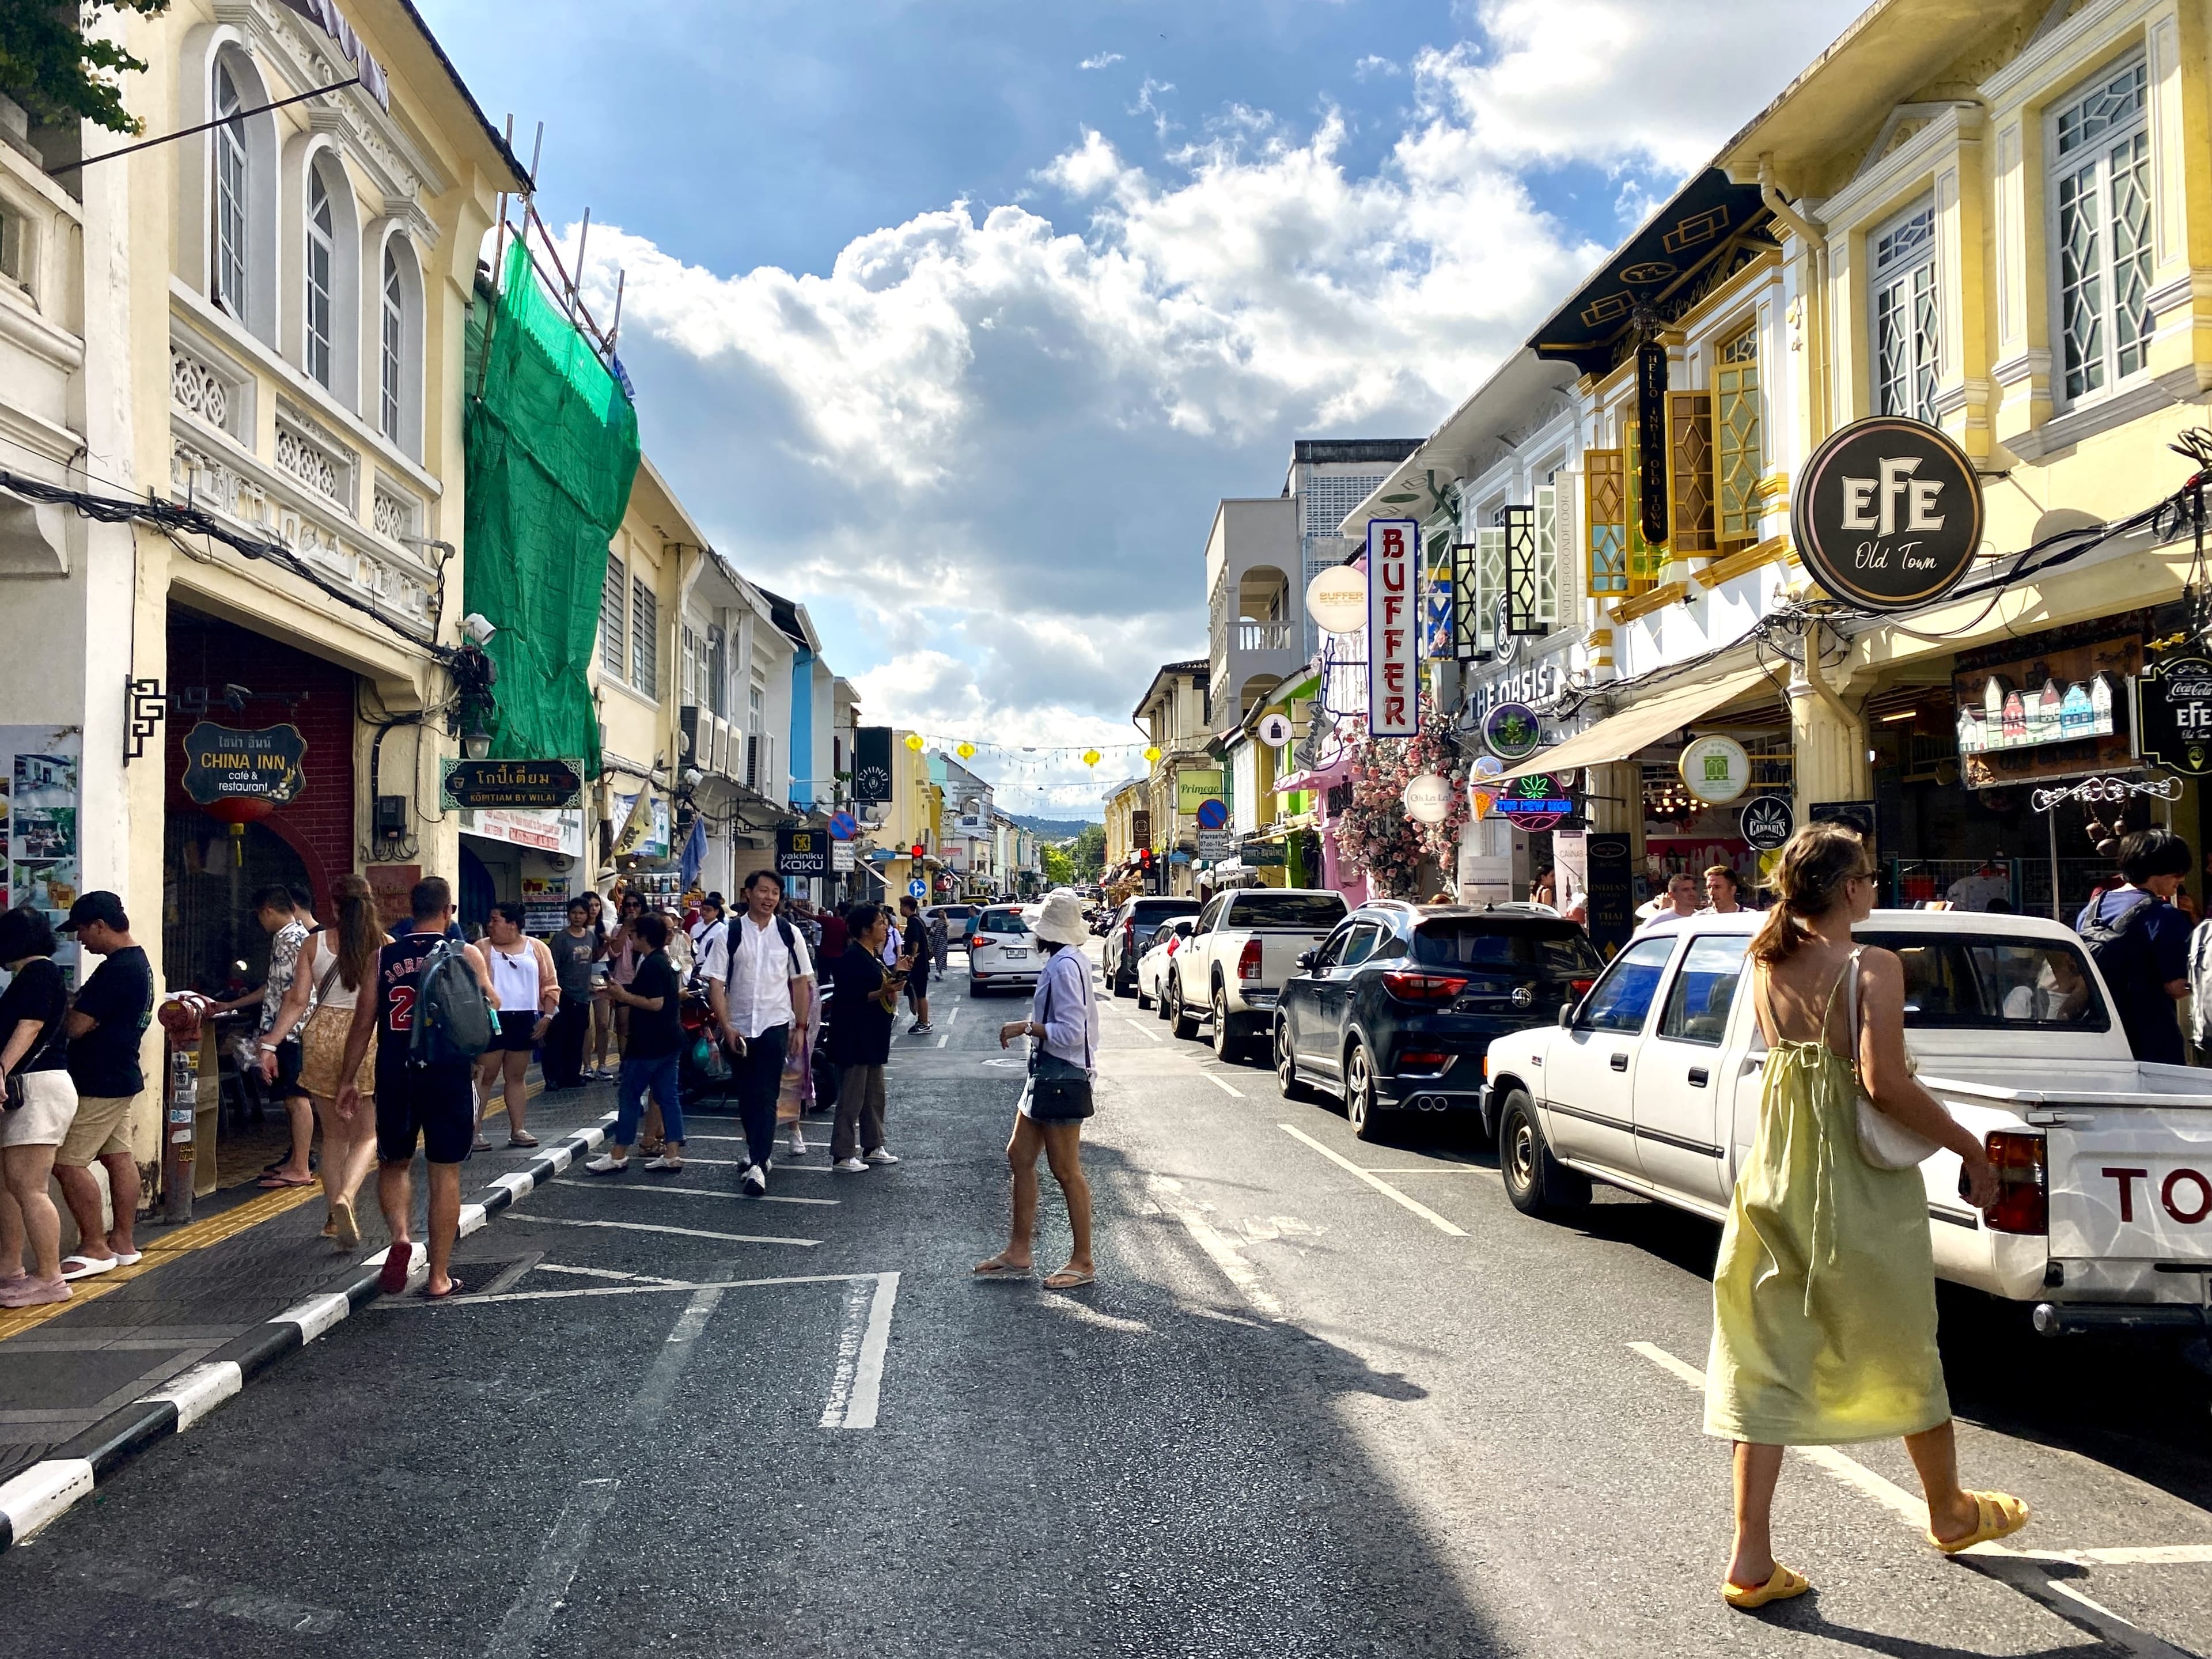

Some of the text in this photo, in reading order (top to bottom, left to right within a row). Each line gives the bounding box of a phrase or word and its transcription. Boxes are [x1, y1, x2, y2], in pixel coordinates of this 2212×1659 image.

[1649, 355, 1658, 398] HELLO
[1649, 407, 1659, 449] INDIA
[1650, 460, 1660, 486] OLD
[1841, 456, 1945, 537] EFE
[1650, 494, 1662, 529] TOWN
[1855, 540, 1938, 570] Old Town
[1319, 592, 1363, 600] BUFFER
[1382, 528, 1406, 728] BUFFER
[1468, 664, 1548, 719] THE OASIS
[2176, 701, 2212, 728] EFE
[202, 752, 285, 770] CHINA INN
[218, 781, 268, 792] restaurant
[228, 770, 258, 780] café &
[529, 793, 555, 802] WILAI
[1410, 794, 1423, 802] Oh
[1425, 793, 1436, 801] La
[1497, 800, 1518, 811] THE
[1520, 800, 1546, 811] NEW
[1749, 821, 1786, 836] CANNABIS
[781, 853, 824, 861] yakiniku
[781, 861, 823, 870] KOKU
[1596, 912, 1623, 921] THAI
[385, 957, 425, 984] JORD
[389, 986, 415, 1031] 2
[2102, 1167, 2212, 1224] TO
